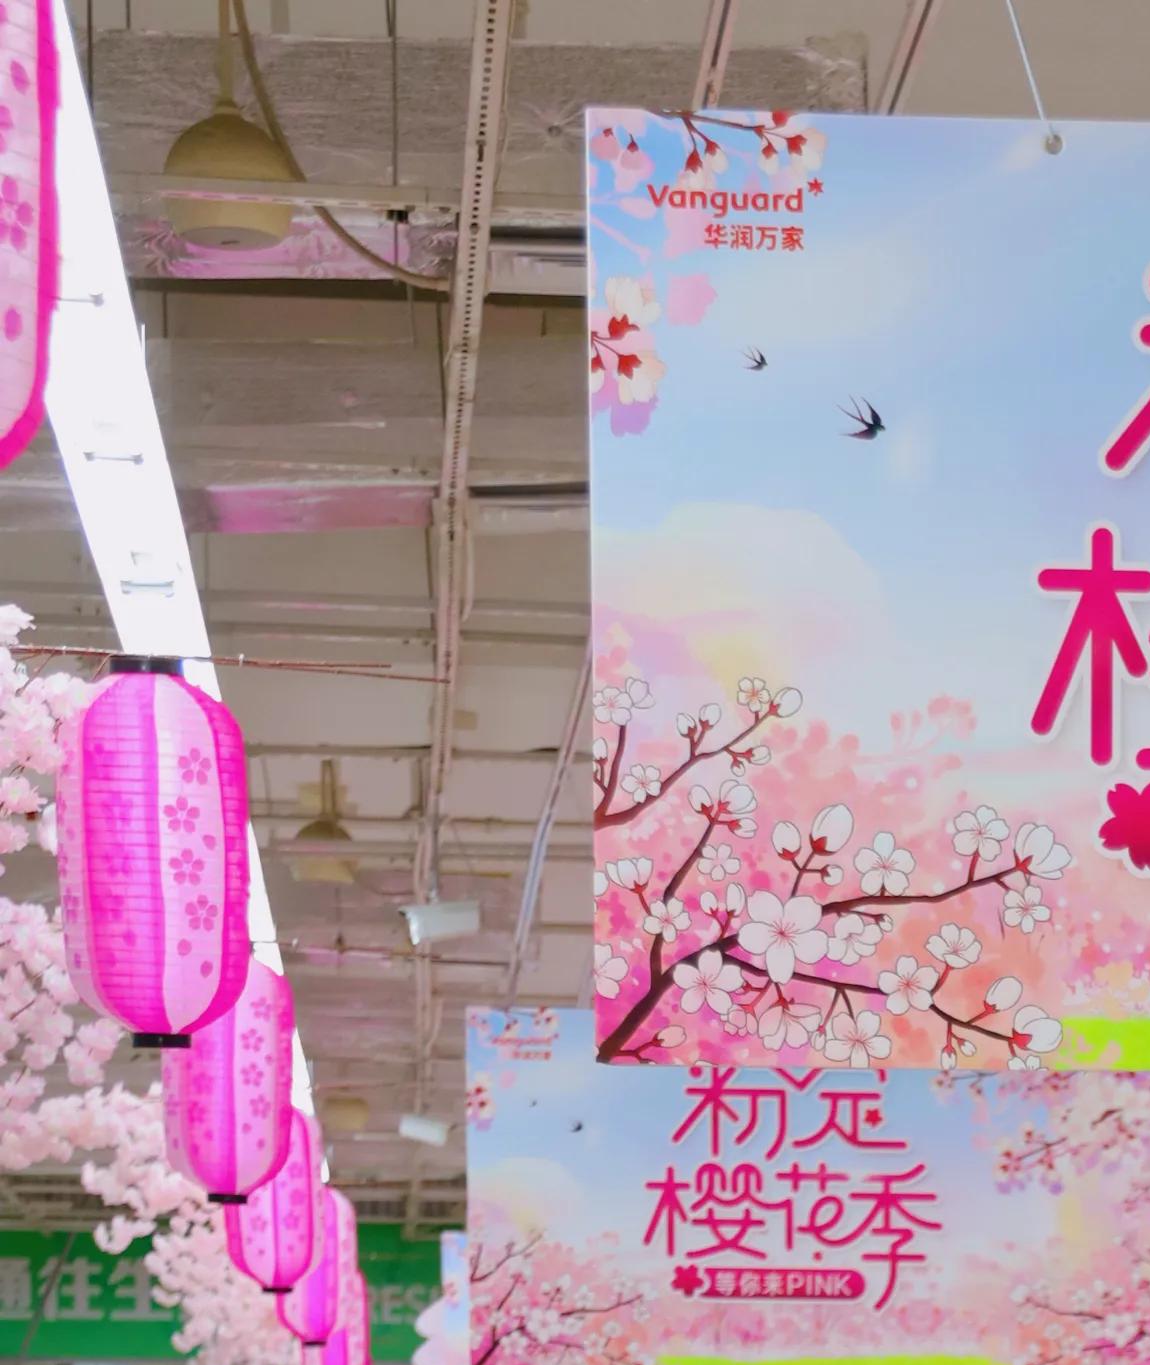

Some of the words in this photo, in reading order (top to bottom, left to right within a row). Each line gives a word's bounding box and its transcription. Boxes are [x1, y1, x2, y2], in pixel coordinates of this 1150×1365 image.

[647, 184, 805, 217] Vanguard
[703, 224, 805, 252] 华润万家
[644, 1161, 942, 1312] 樱花季
